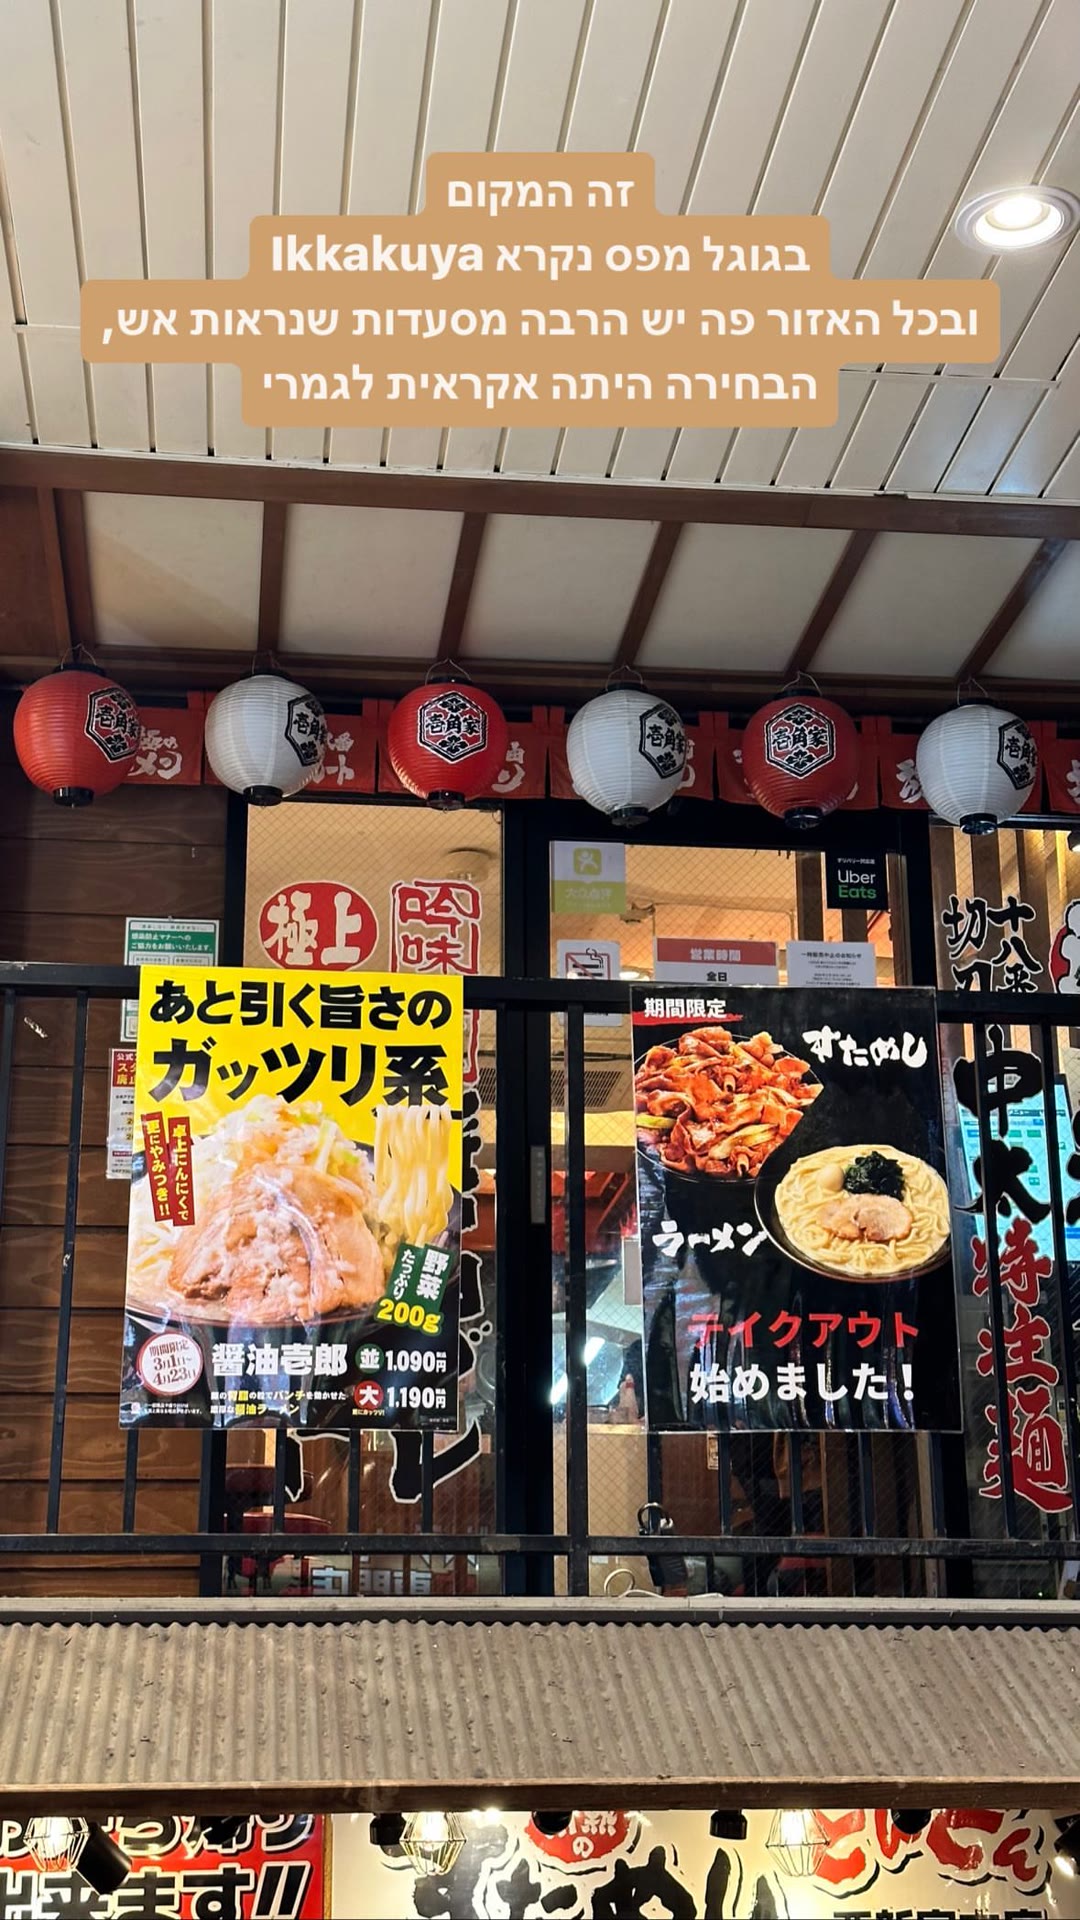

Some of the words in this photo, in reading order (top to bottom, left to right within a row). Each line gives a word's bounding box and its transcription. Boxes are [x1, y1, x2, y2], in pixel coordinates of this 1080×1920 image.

[424, 713, 482, 737] 壱角家
[770, 725, 827, 753] 壱角家
[838, 869, 877, 884] Uber
[838, 884, 877, 899] Eats
[264, 889, 364, 966] 極上
[396, 881, 482, 974] 吟味
[690, 947, 742, 963] 営業時間
[150, 979, 452, 1031] あと引く旨さの
[644, 998, 727, 1020] 期間限定
[802, 1025, 928, 1069] すためし
[148, 1036, 451, 1107] ガッツリ系
[172, 1124, 192, 1222] 卓上にんにくで
[652, 1220, 769, 1257] ラーメン
[393, 1248, 416, 1301] たっぷり
[416, 1248, 450, 1301] 野菜
[376, 1299, 442, 1335] 200g
[687, 1309, 919, 1350] テイクアウト
[211, 1342, 348, 1377] 醤油壱郎
[359, 1347, 380, 1369] 並
[358, 1385, 379, 1407] 大
[690, 1362, 915, 1405] 始めました!
